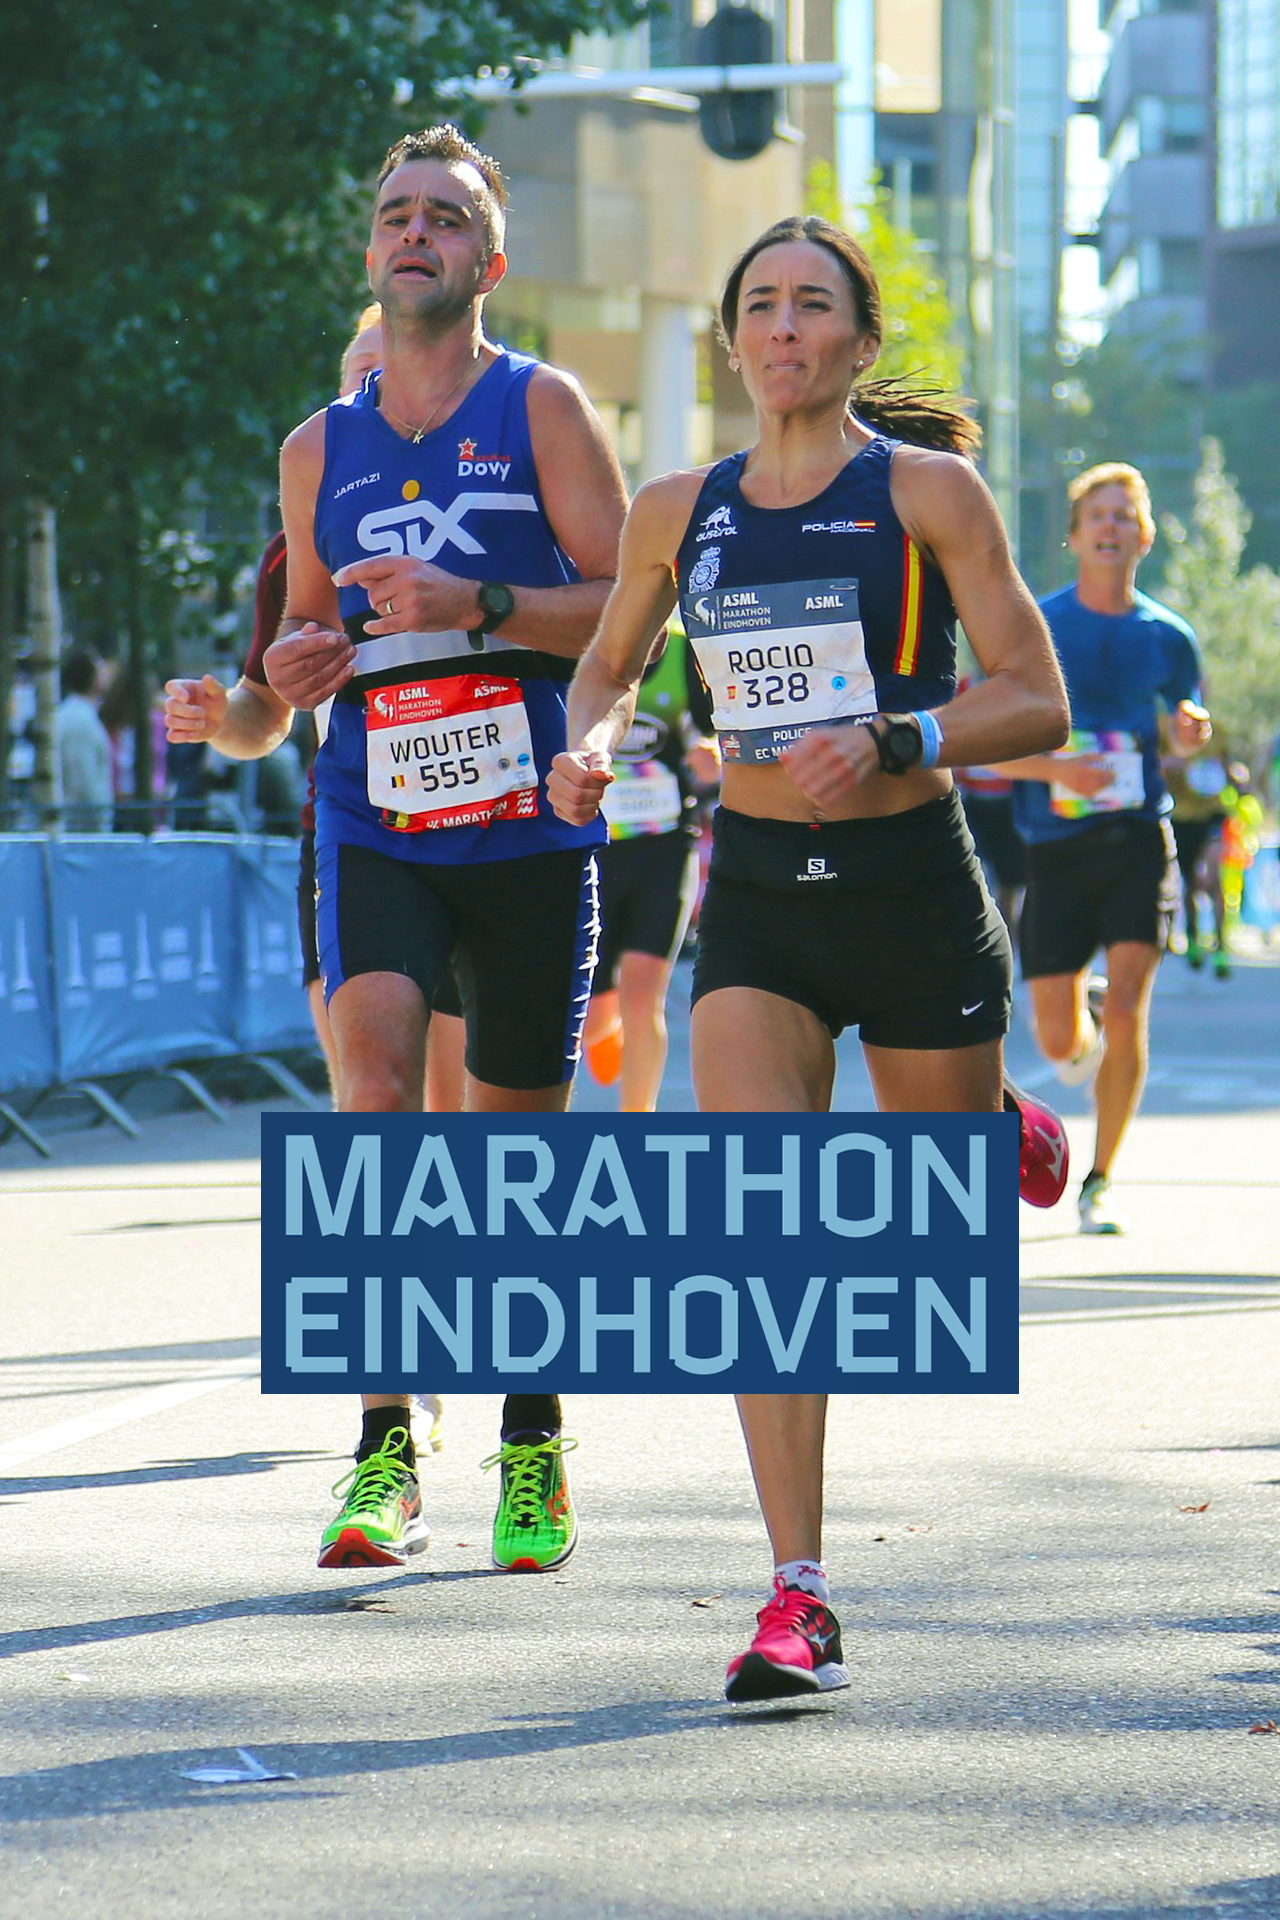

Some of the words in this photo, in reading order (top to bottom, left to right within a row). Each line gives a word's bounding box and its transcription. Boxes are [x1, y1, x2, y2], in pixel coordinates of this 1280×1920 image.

[334, 472, 380, 499] JARTAZI
[802, 521, 855, 533] POLICIA
[722, 592, 759, 608] ASML
[805, 595, 844, 611] ASML
[722, 607, 771, 619] MARATHON
[723, 617, 771, 630] EINDHOVEN
[728, 643, 814, 675] ROCIO
[398, 687, 430, 702] ASML
[473, 685, 509, 698] ASML
[743, 672, 809, 709] 328
[398, 699, 442, 711] MARATHON
[399, 707, 443, 721] EINDHOVEN
[390, 722, 501, 764] WOUTER
[755, 748, 770, 760] EC
[420, 757, 480, 792] 555
